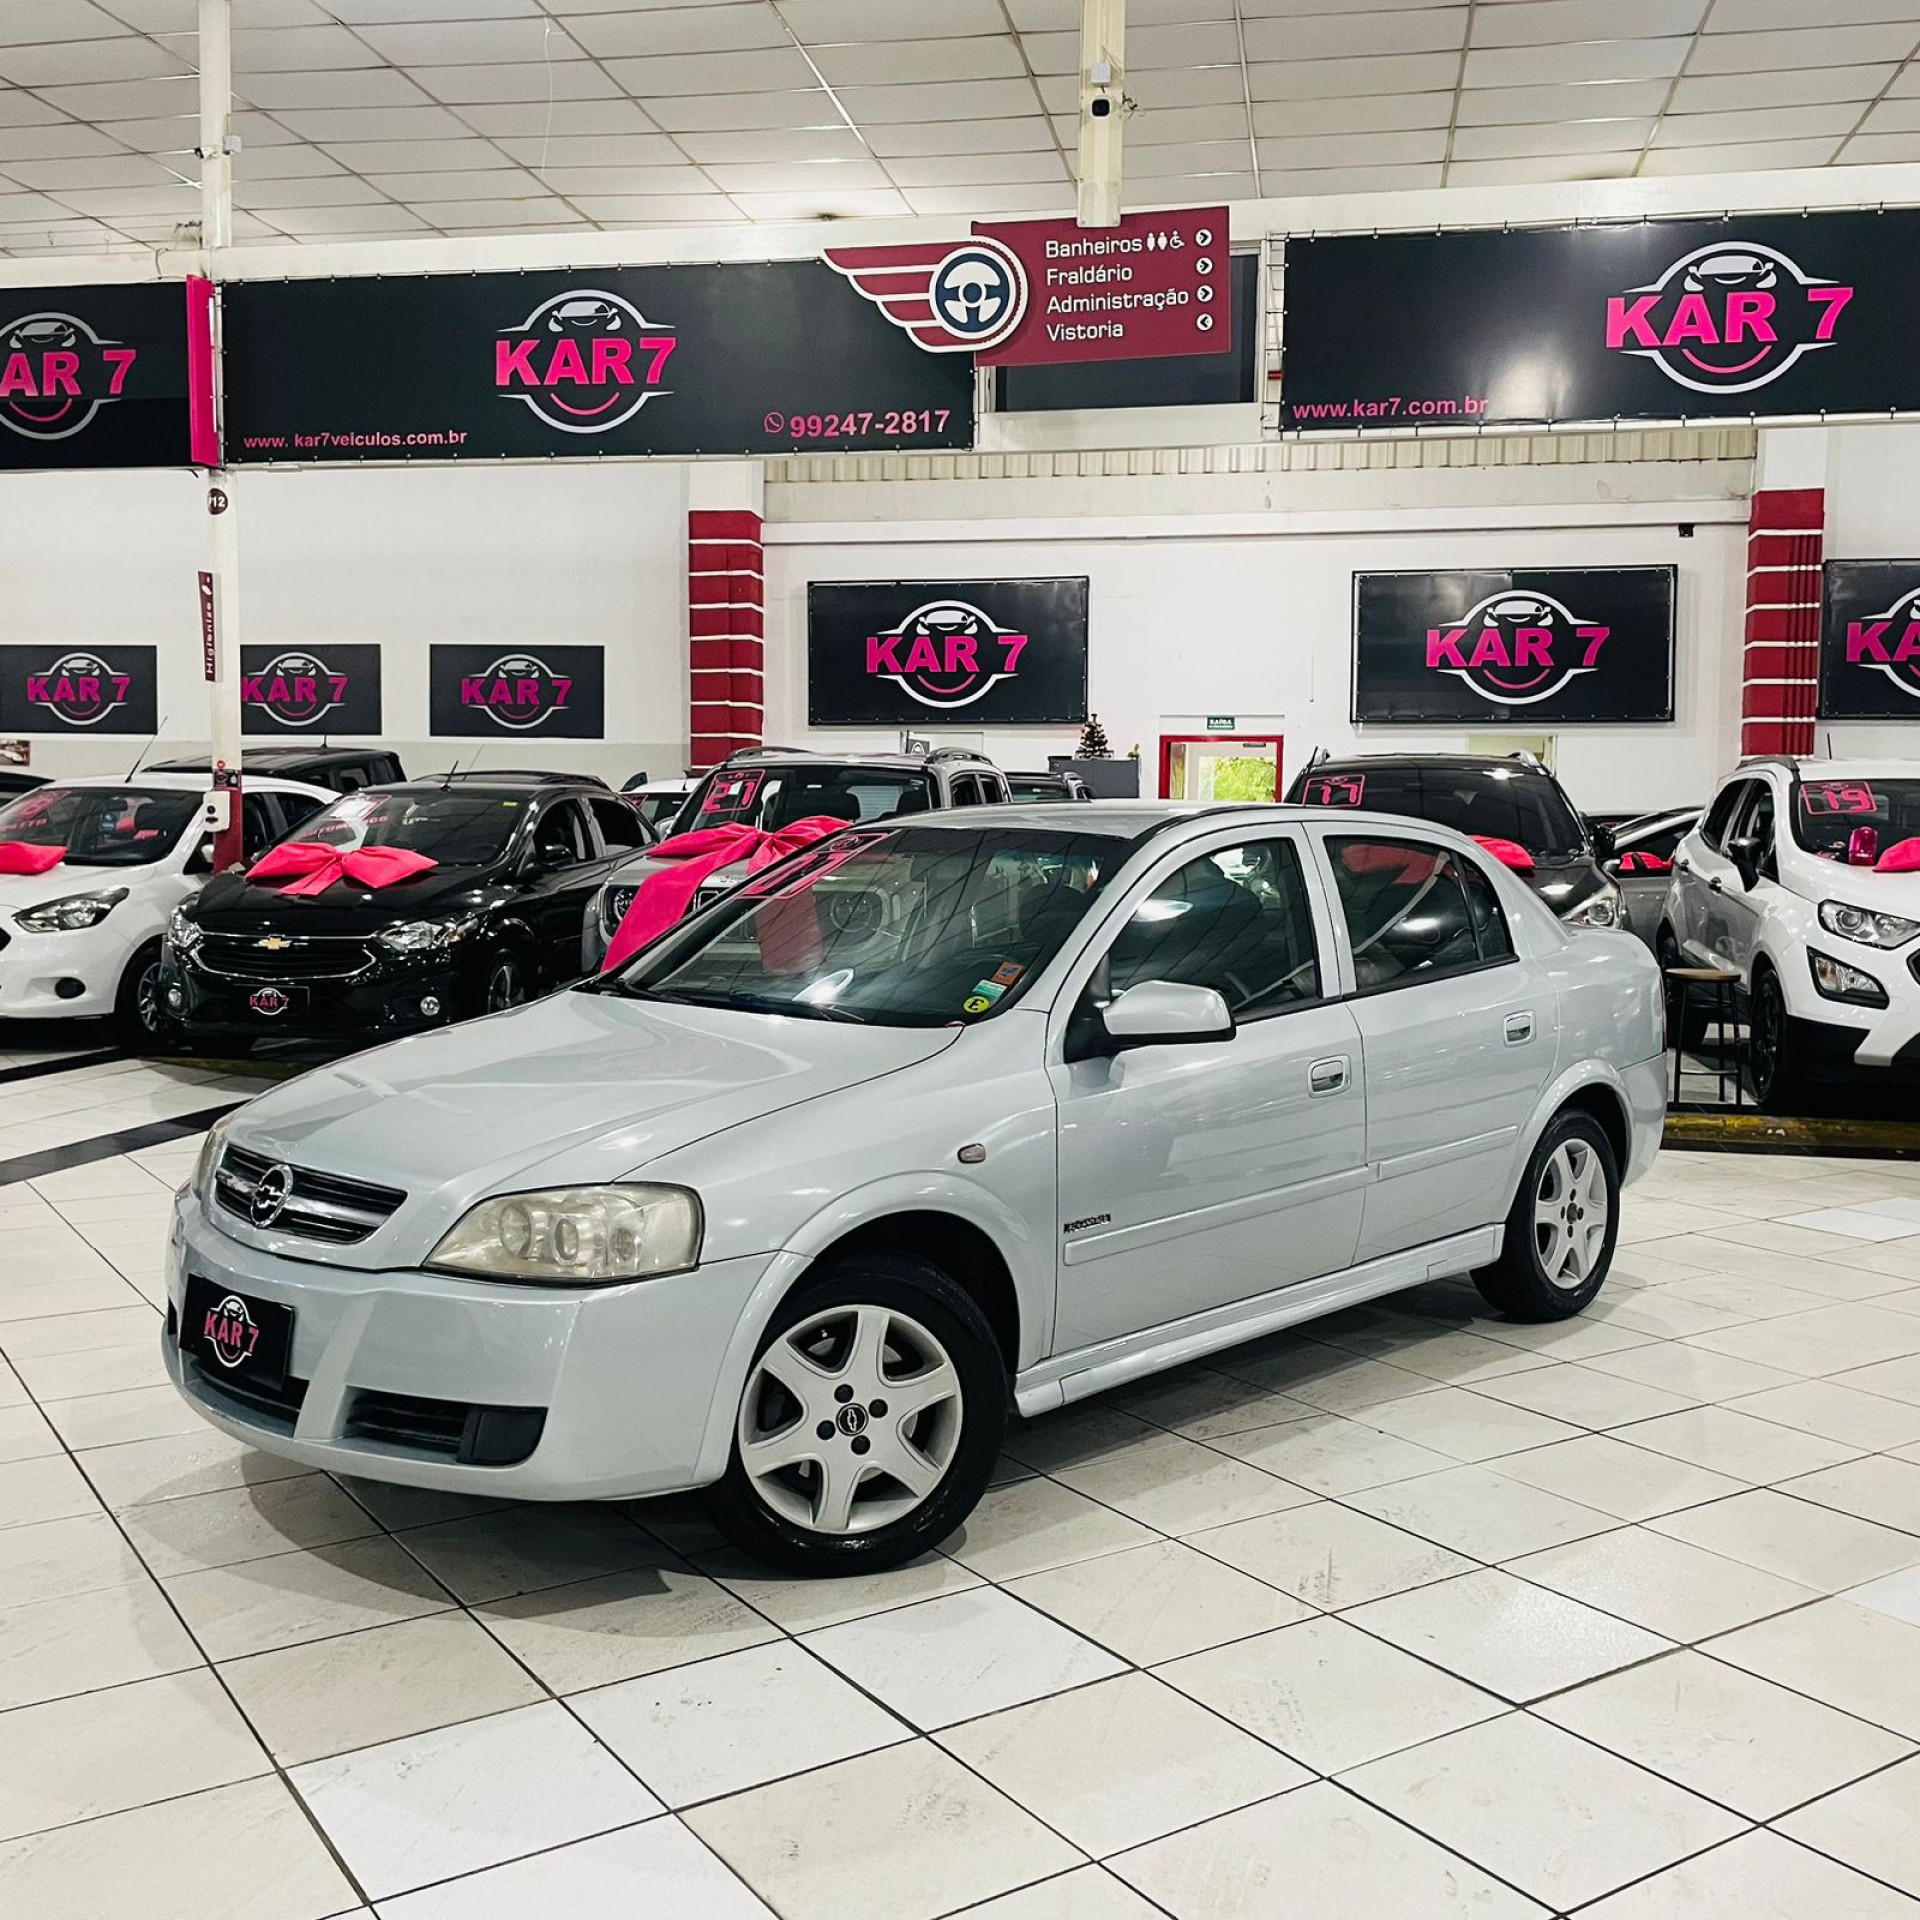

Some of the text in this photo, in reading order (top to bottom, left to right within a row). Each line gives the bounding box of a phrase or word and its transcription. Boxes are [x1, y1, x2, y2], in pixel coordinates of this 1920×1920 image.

[1045, 236, 1143, 259] Banheiros
[1046, 264, 1133, 287] Fraldário
[1046, 288, 1189, 314] Administração
[1046, 320, 1124, 342] Vistoria
[1605, 286, 1855, 350] KAR 7
[0, 348, 138, 397] AR 7
[1292, 396, 1489, 420] www.kar7.com.br
[294, 429, 468, 447] kar7veiculos.com.br
[789, 409, 951, 439] 99247-2817
[865, 634, 1029, 674] KAR 7
[1425, 626, 1611, 668] KAR 7
[1846, 621, 1920, 663] KA
[27, 675, 131, 704] KAR 7
[240, 676, 348, 705] KAR 7
[460, 677, 573, 707] KAR 7
[705, 781, 756, 811] 21
[1321, 784, 1358, 804] 17
[1822, 788, 1871, 811] 19
[203, 1310, 260, 1353] KAR 7
